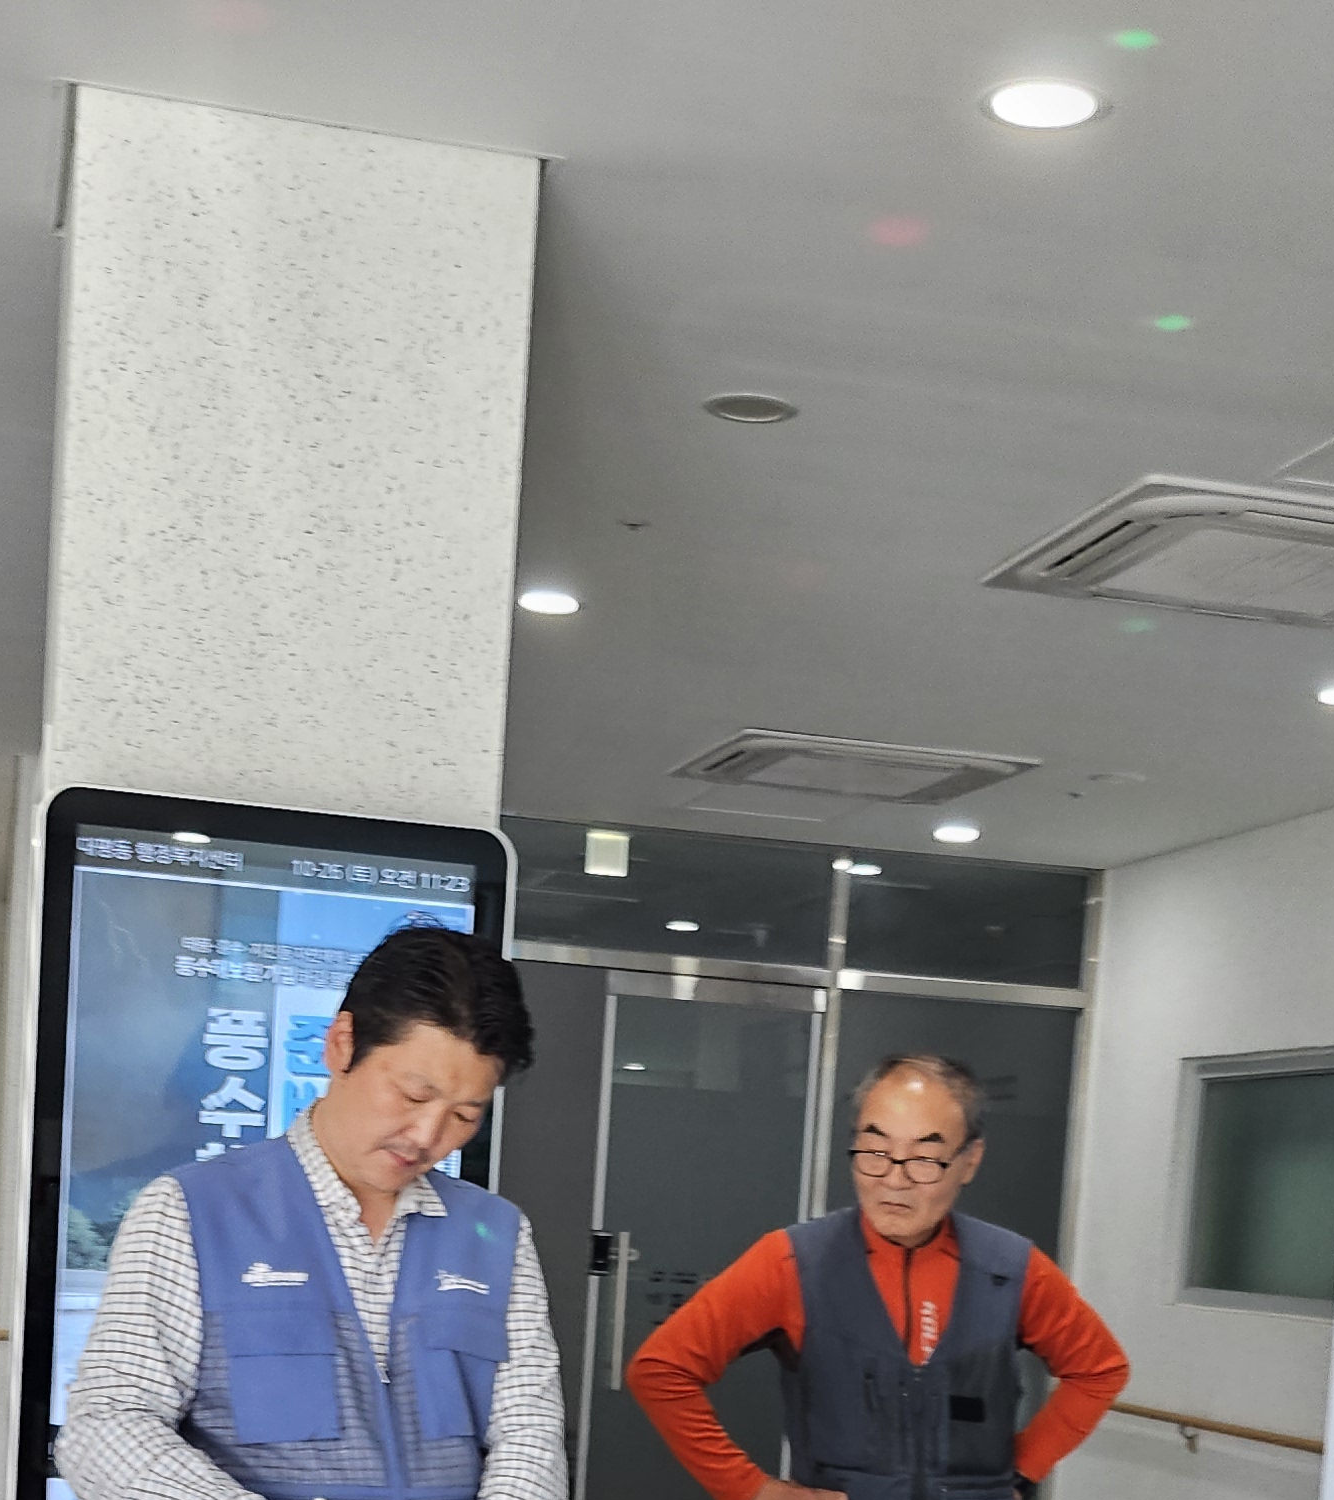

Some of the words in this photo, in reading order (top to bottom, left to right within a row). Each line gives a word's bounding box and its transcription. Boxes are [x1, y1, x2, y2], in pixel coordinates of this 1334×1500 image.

[76, 837, 133, 860] 대평동
[134, 841, 244, 872] 행정복지센터
[346, 864, 379, 884] (토)
[379, 868, 418, 889] 오전
